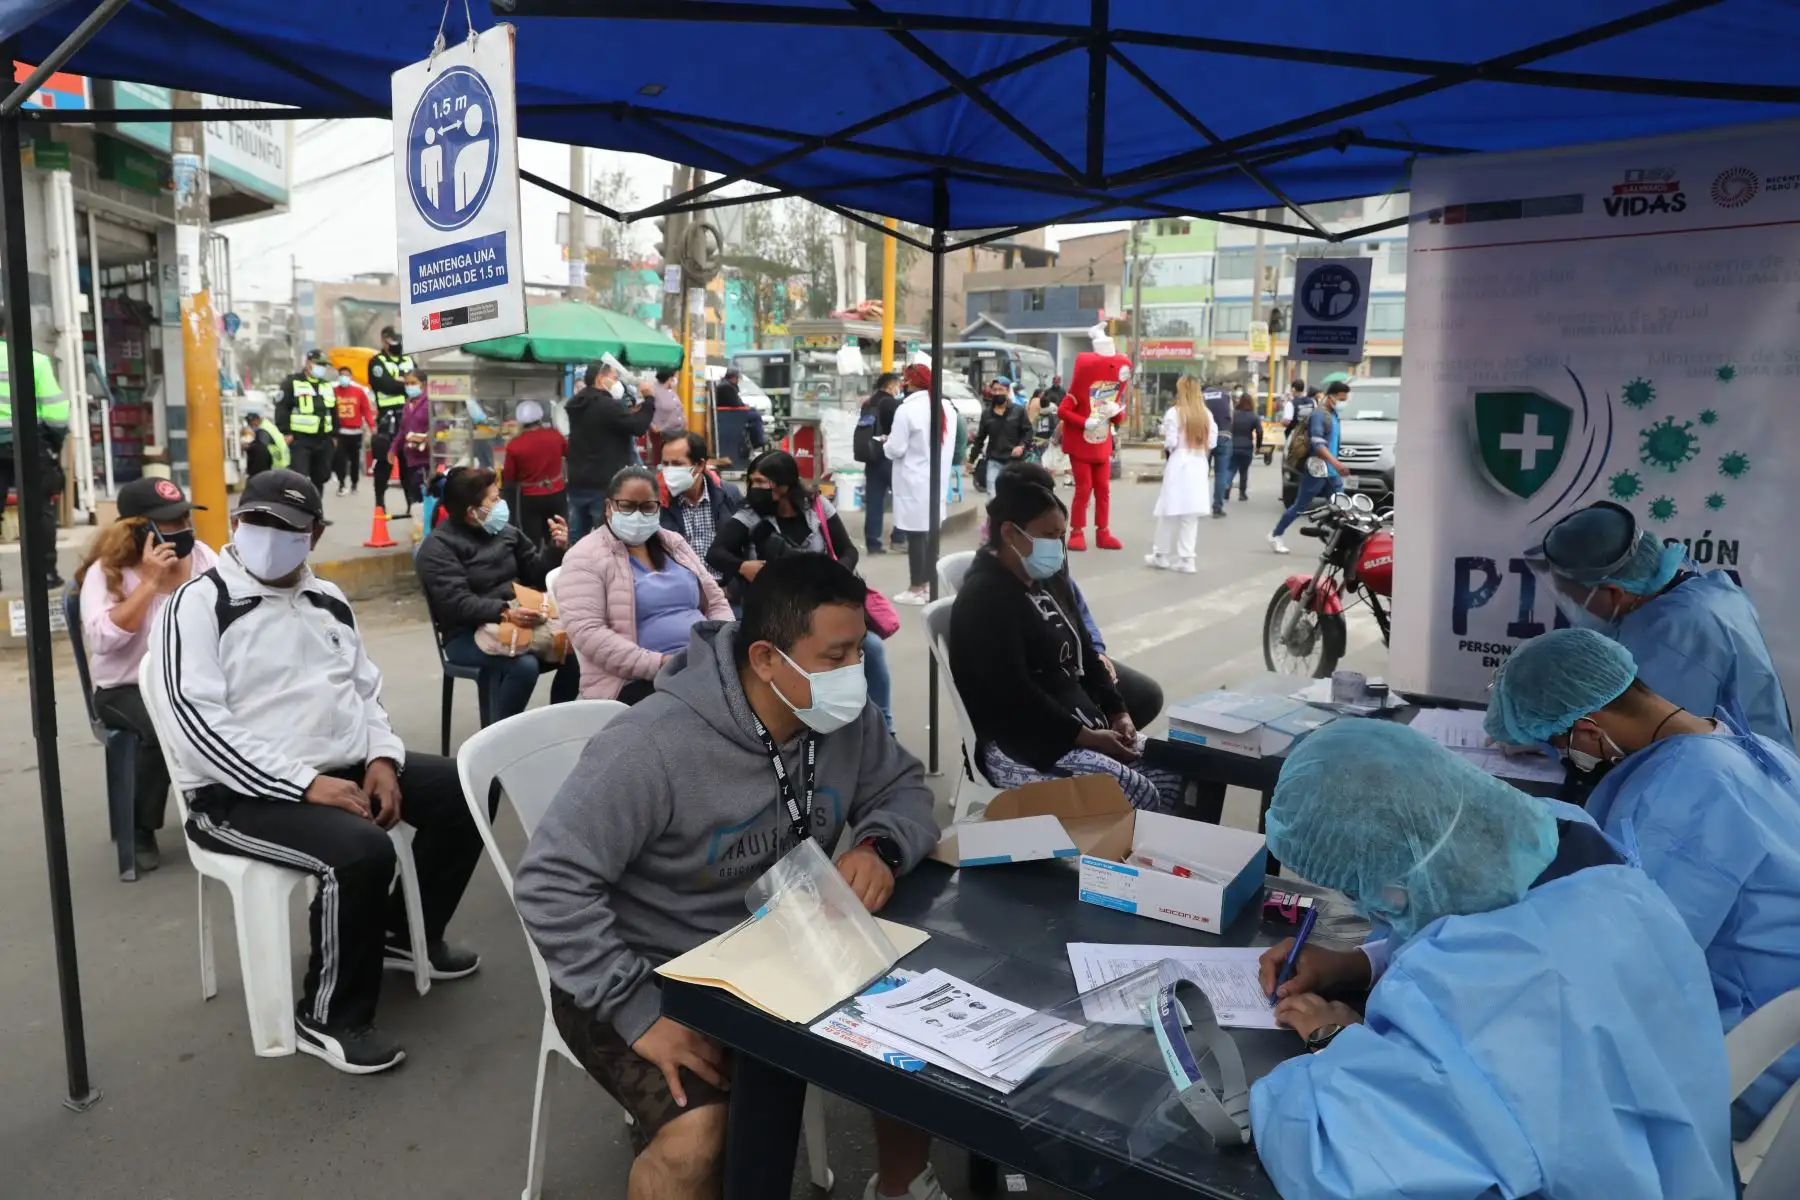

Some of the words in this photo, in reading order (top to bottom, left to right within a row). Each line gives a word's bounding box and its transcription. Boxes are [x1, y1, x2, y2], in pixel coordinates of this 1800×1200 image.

[433, 97, 451, 119] 1.5
[455, 95, 467, 111] m
[228, 121, 282, 169] TRIUNFO
[1603, 193, 1686, 217] VIDAS
[419, 254, 472, 277] MANTENGA
[474, 248, 496, 263] UNA
[413, 275, 462, 295] DISTANCIA
[464, 269, 477, 283] DE
[480, 265, 493, 280] 1.5
[496, 265, 505, 276] m
[773, 754, 786, 780] PUMA
[787, 798, 801, 822] PUMA
